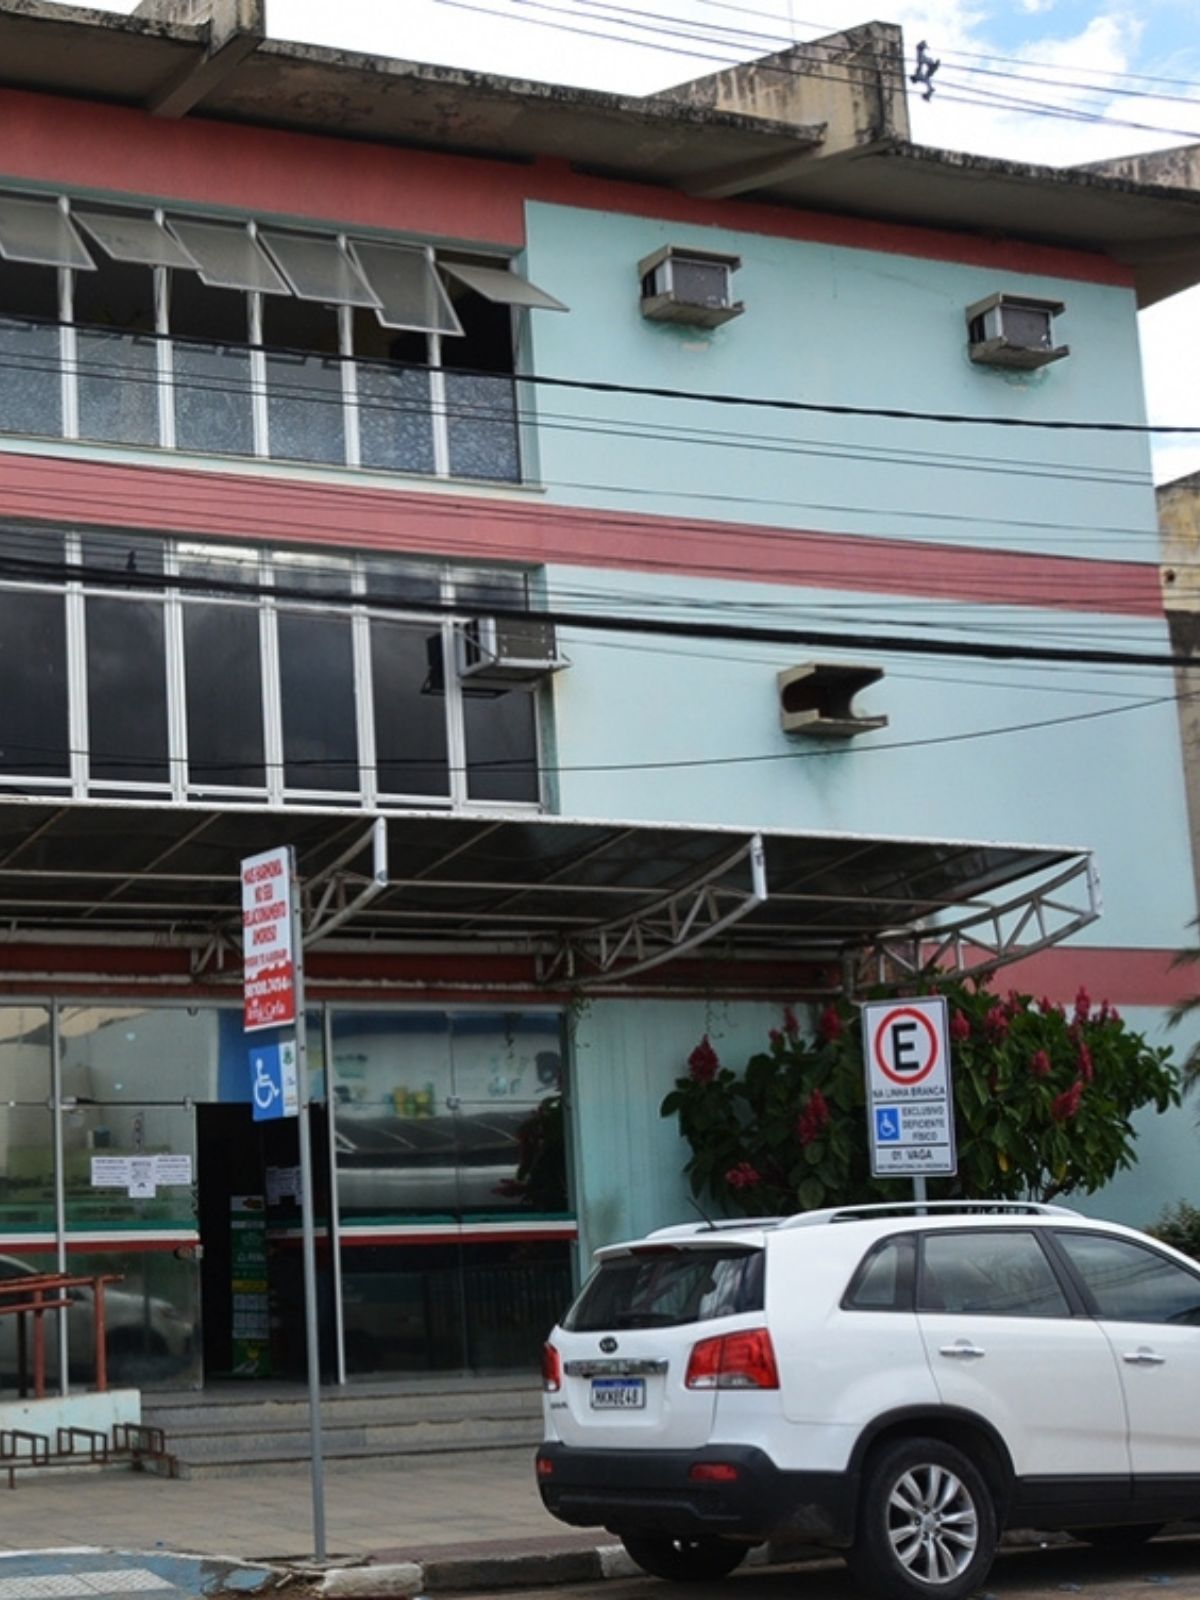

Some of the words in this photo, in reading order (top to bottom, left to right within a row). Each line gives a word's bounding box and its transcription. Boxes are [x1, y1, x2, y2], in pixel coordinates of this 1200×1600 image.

[891, 1022, 920, 1071] E
[873, 1090, 883, 1098] NA
[885, 1088, 909, 1098] LINHA
[911, 1086, 945, 1097] BRANCA
[902, 1106, 944, 1117] EXCLUSIVO
[902, 1119, 945, 1130] DEFICIENTE
[906, 1148, 933, 1160] VAGA
